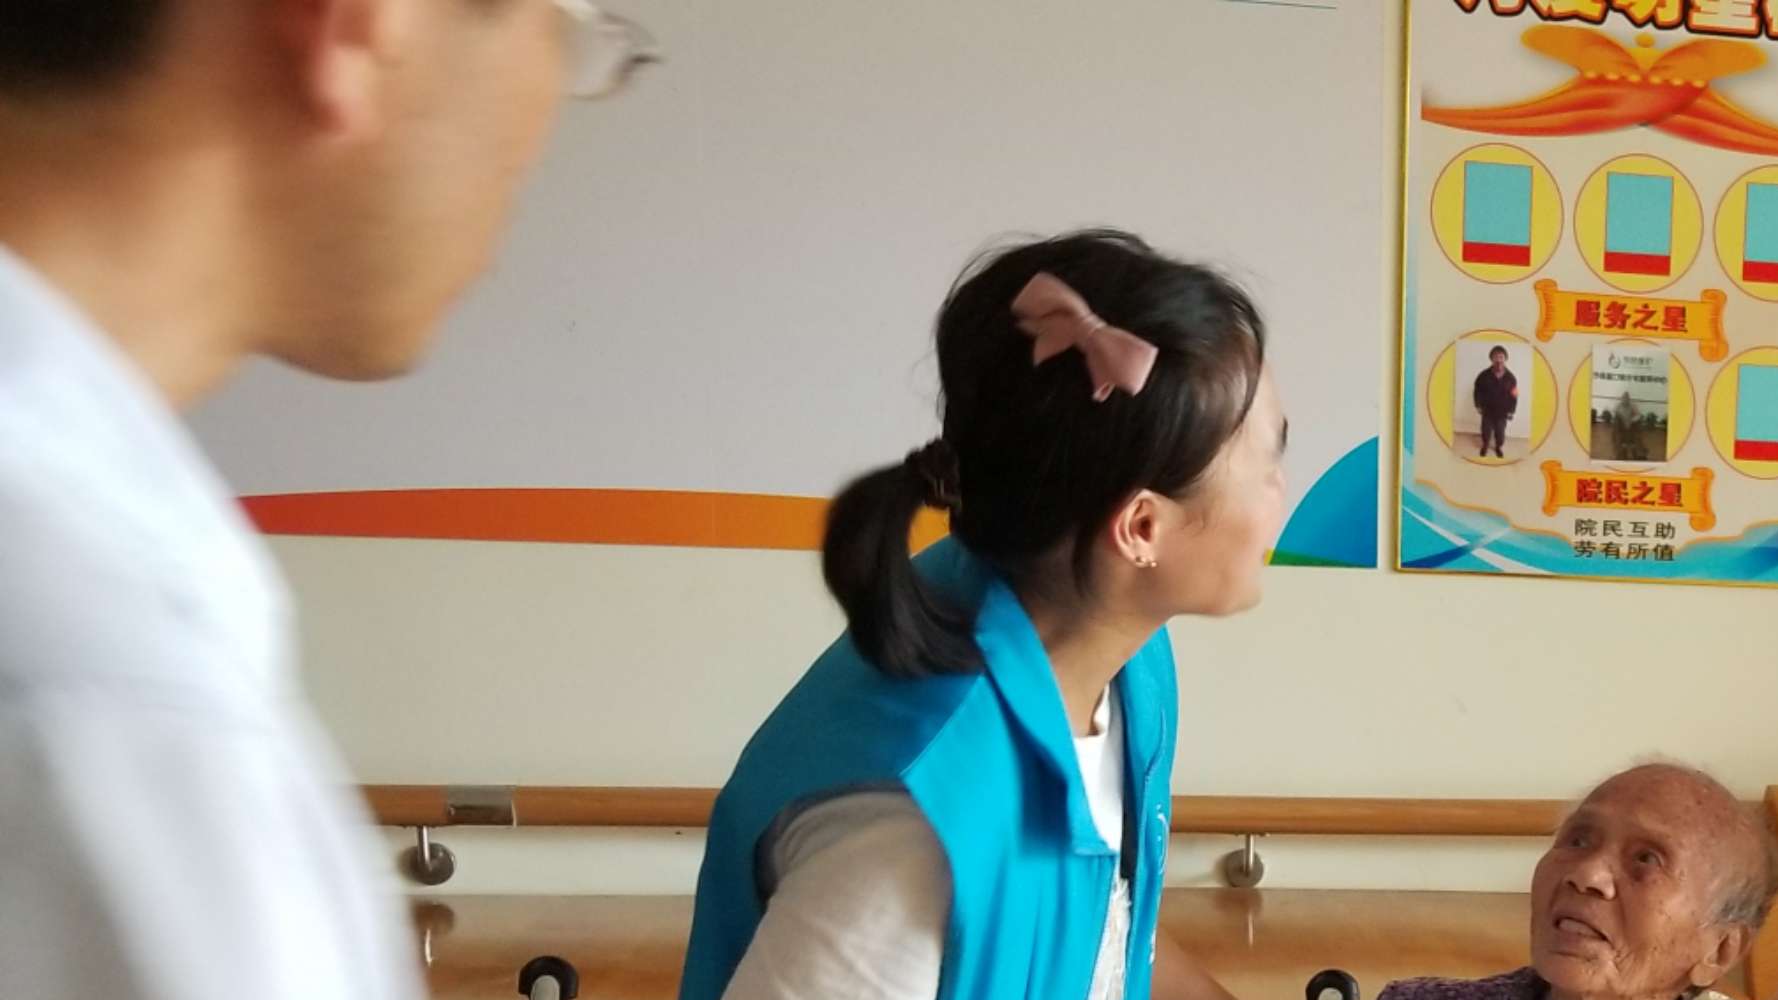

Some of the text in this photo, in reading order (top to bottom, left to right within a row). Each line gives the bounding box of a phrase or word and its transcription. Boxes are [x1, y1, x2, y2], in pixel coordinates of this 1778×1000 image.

[1574, 299, 1688, 333] 服务之星
[1576, 478, 1684, 507] 院民之星
[1574, 519, 1676, 539] 院民互助
[1574, 541, 1675, 561] 劳有所值
